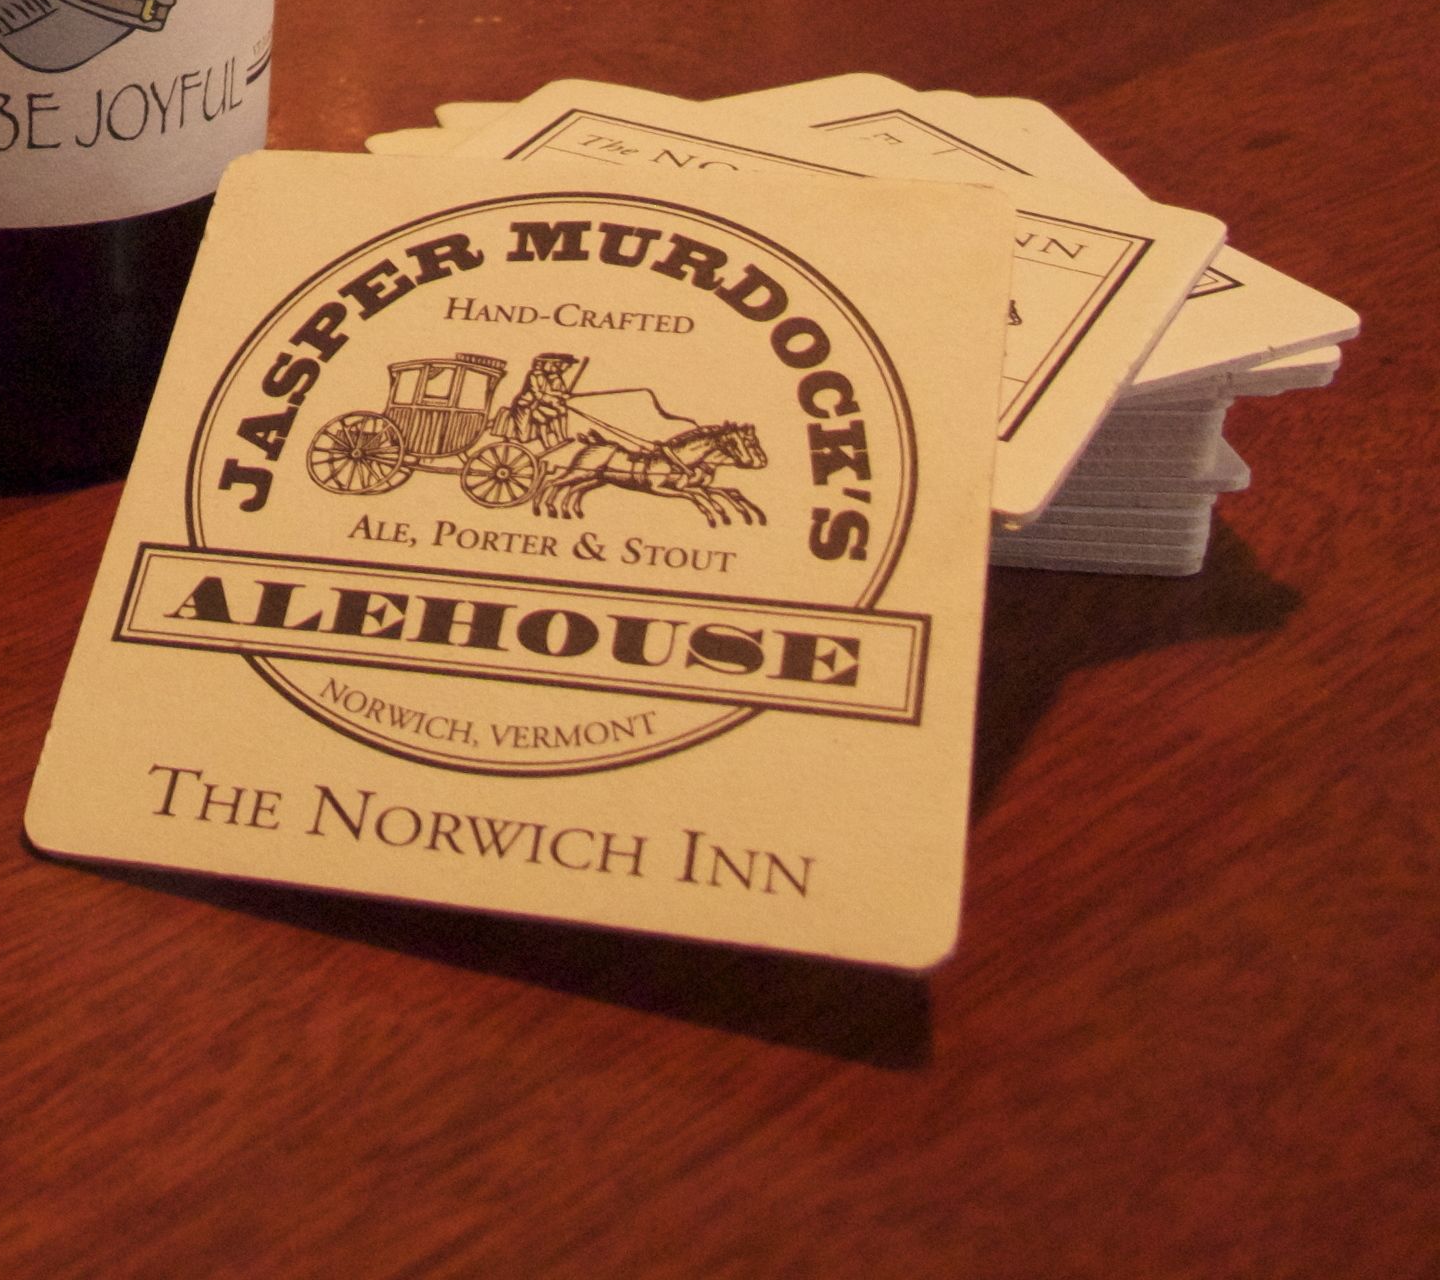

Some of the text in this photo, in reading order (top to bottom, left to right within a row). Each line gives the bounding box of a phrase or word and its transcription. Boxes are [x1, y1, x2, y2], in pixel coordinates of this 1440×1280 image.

[74, 56, 244, 149] JOYFUL
[576, 133, 641, 158] The
[443, 296, 696, 337] HAND-CRAFTED
[217, 219, 873, 564] JASPER MURDOCK'S
[347, 512, 739, 575] ALE, PORTER & STOUT
[163, 574, 864, 690] ALEHOUSE
[317, 675, 662, 752] NORWICH, VERMONT
[147, 764, 819, 901] THE NORWICH INN
